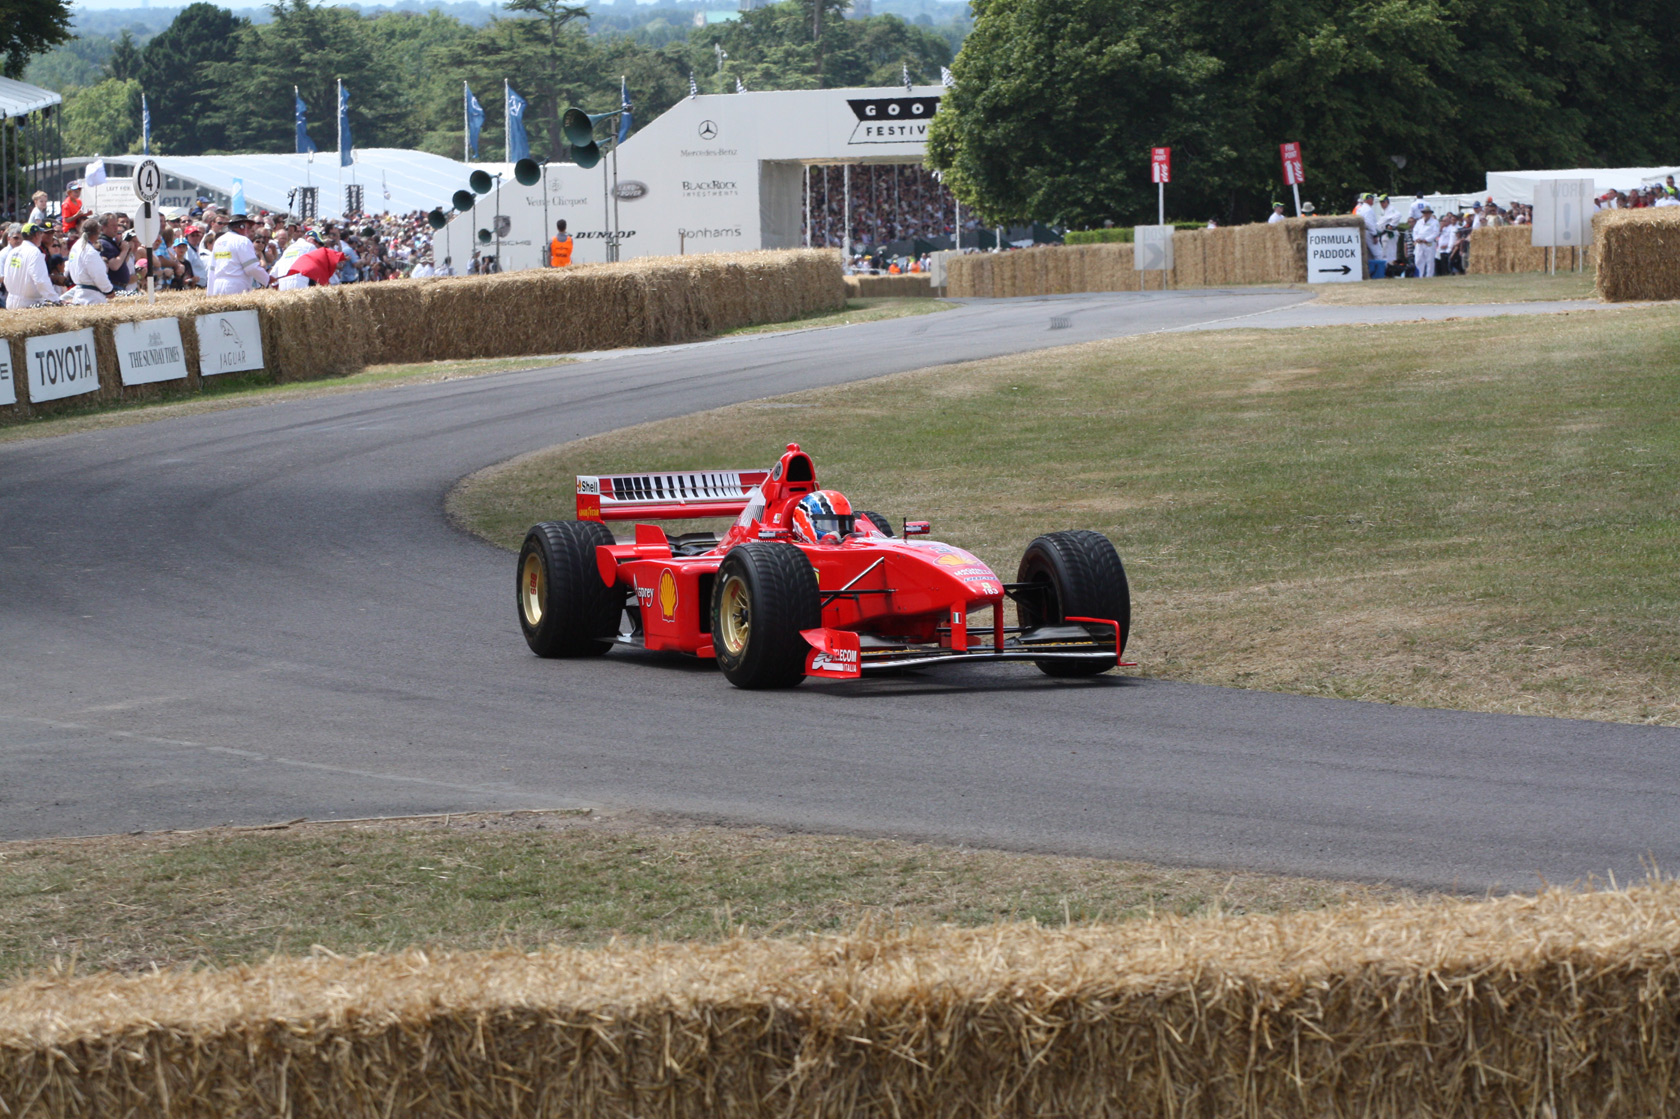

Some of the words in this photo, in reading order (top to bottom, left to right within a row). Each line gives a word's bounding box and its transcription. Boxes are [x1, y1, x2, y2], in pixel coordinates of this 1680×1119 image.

[145, 169, 153, 191] 4
[575, 230, 637, 239] DUNLOP
[678, 227, 742, 239] Bonhams
[1309, 235, 1352, 245] FORMULA
[1355, 235, 1360, 244] 1
[1313, 249, 1356, 259] PADDOCK
[128, 351, 143, 368] THE
[142, 348, 165, 367] SUNDAY
[164, 346, 180, 363] TIMES
[219, 350, 247, 368] JAGUAR
[35, 343, 93, 386] TOYOTA
[581, 480, 598, 493] Shell
